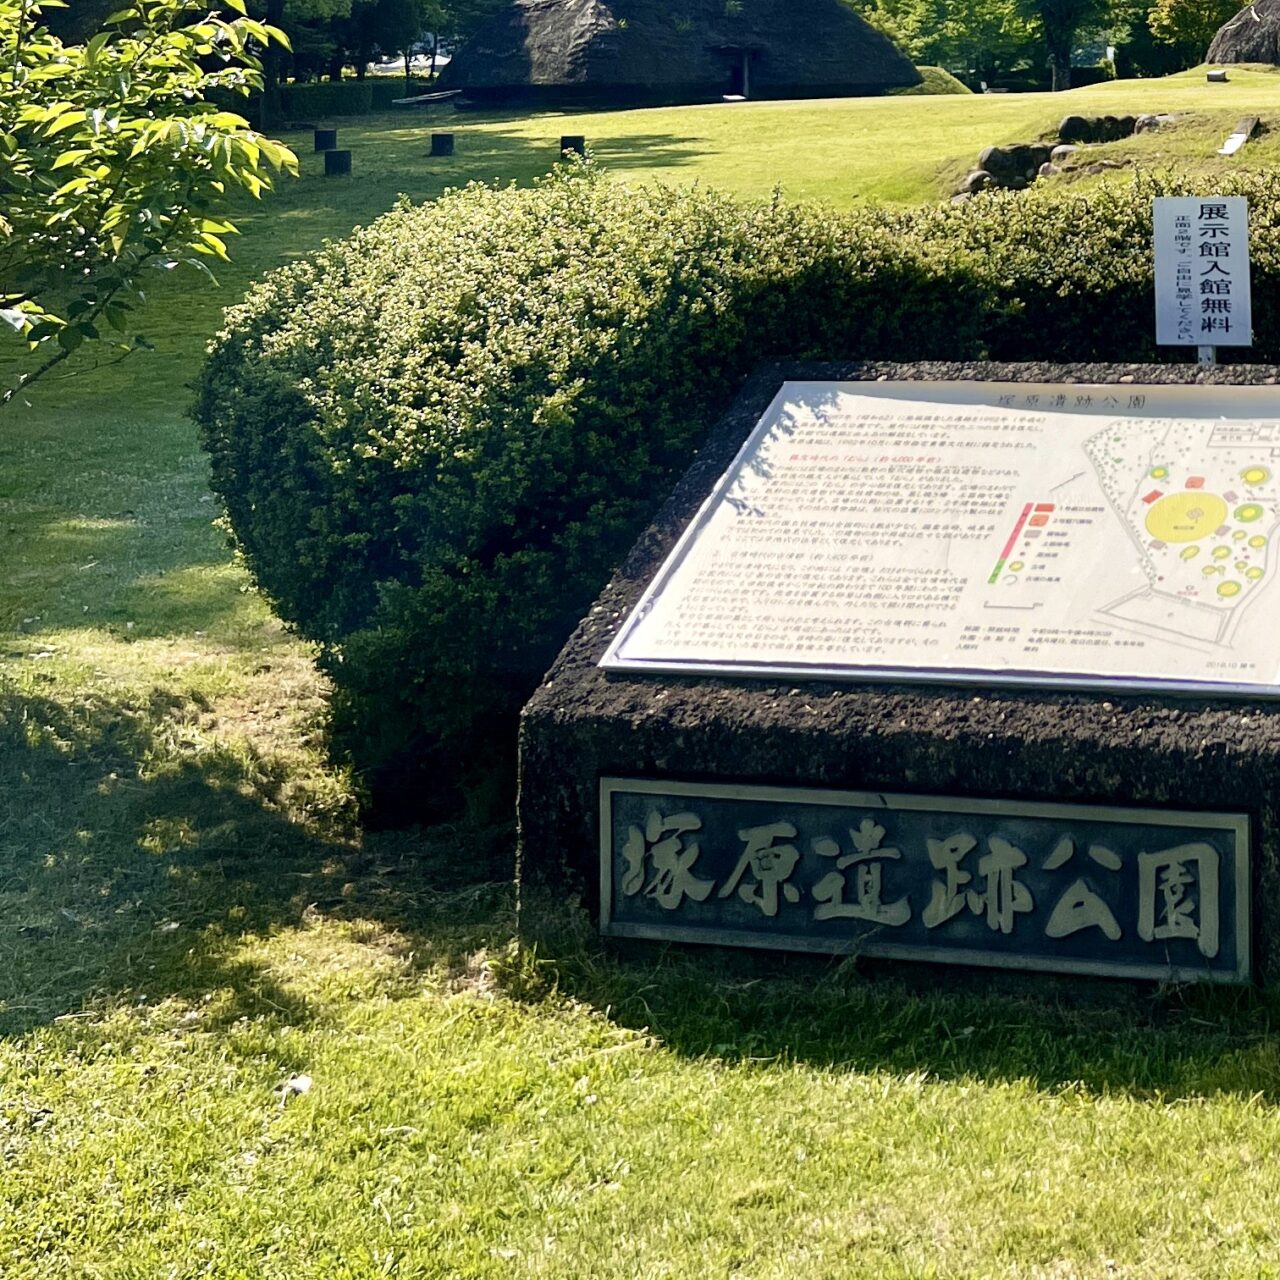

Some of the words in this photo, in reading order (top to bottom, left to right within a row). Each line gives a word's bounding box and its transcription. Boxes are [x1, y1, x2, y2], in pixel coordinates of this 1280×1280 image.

[1198, 203, 1233, 333] 展示館入館無料
[621, 810, 1221, 959] 塚原遺跡公園
